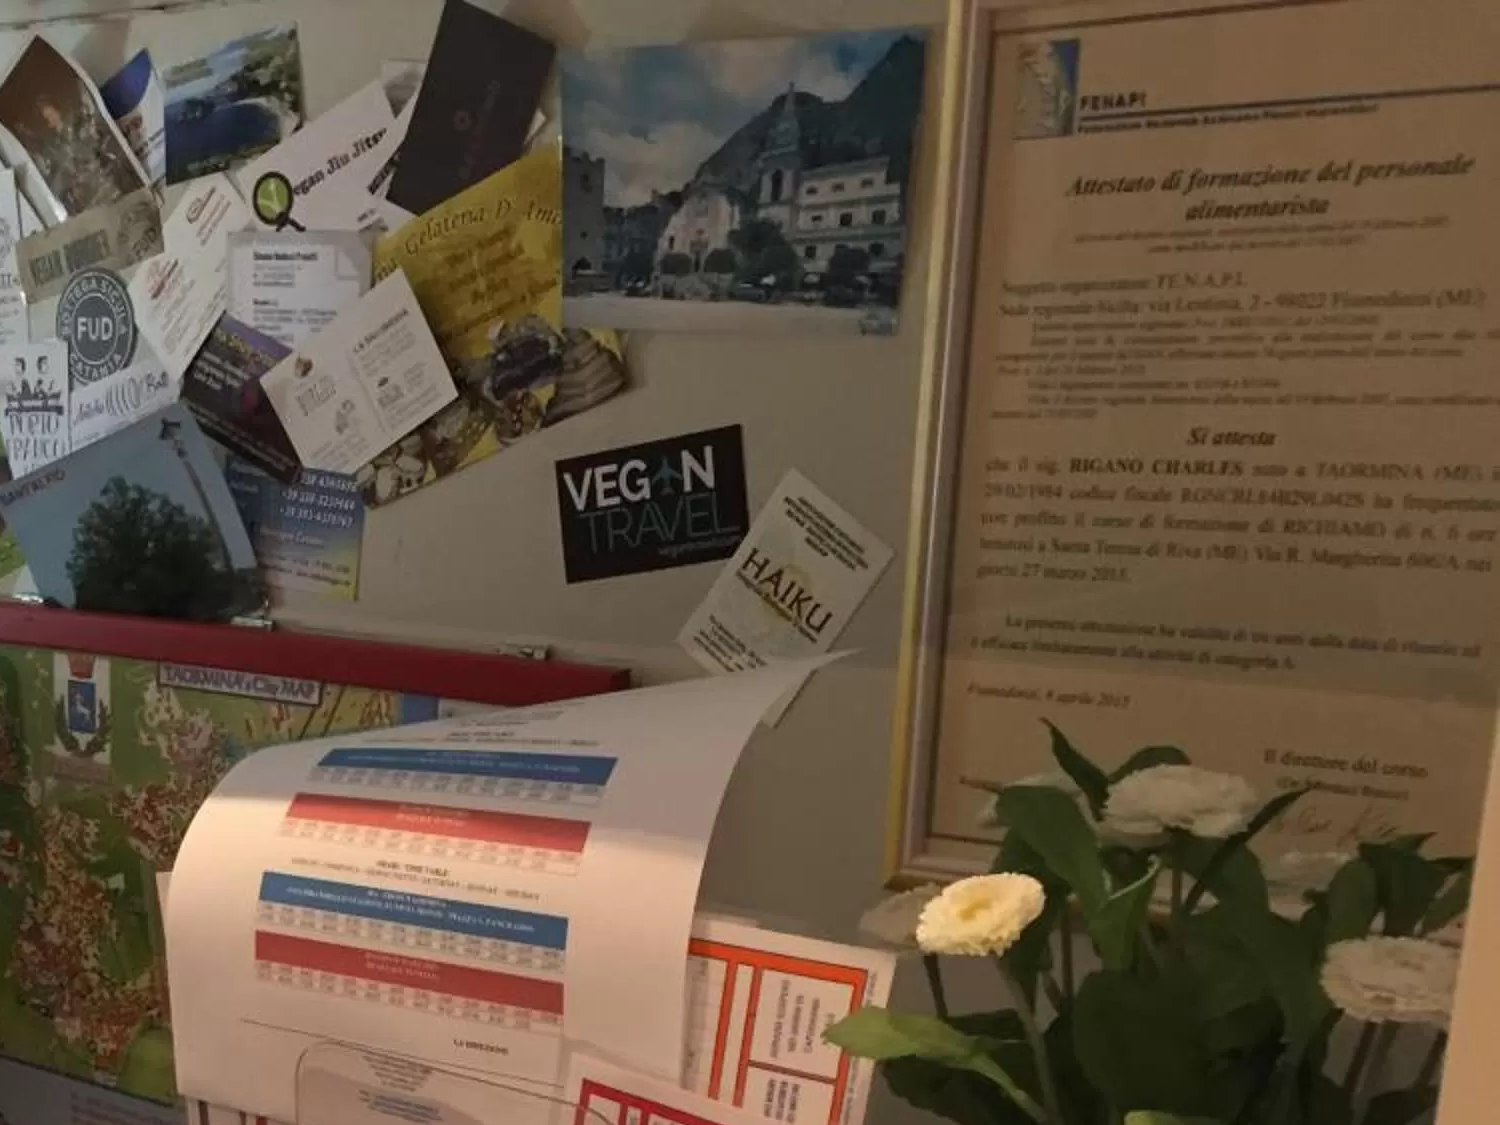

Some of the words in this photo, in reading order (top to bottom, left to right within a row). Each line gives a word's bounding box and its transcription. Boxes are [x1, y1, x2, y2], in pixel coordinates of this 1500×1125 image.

[1079, 91, 1147, 111] FENAPI
[1065, 175, 1156, 197] Attestato
[1160, 169, 1182, 192] di
[1182, 165, 1312, 196] formazione
[1315, 160, 1354, 183] del
[1352, 153, 1477, 188] personale
[1184, 195, 1331, 222] alimentarista
[76, 316, 115, 342] FUD
[1186, 426, 1211, 446] Si
[1211, 430, 1277, 447] attesta
[1068, 456, 1145, 474] RIGANO
[1151, 457, 1244, 477] CHARLES
[579, 492, 741, 555] TRAVEL
[741, 547, 834, 635] HAIKU
